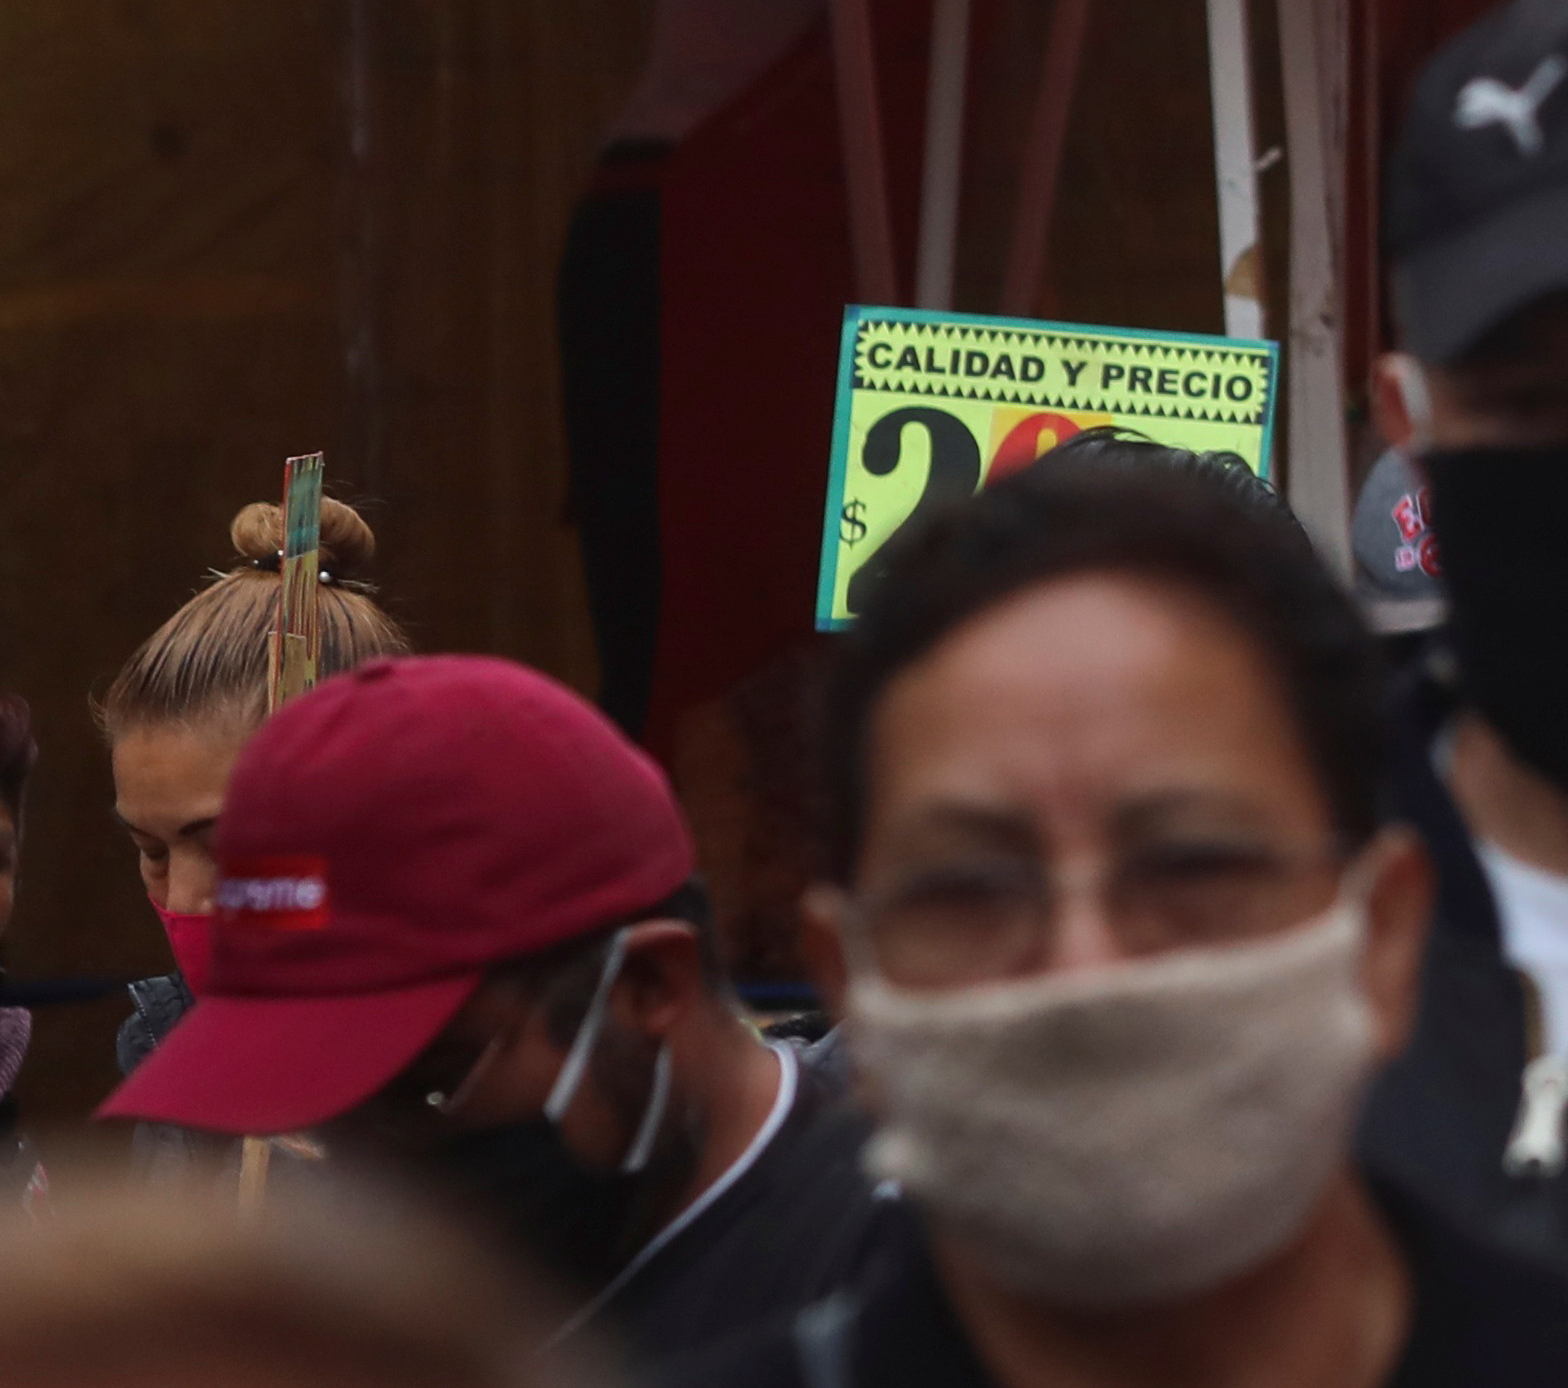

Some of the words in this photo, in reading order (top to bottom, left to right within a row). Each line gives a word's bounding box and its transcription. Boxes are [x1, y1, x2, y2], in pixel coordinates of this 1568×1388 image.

[867, 342, 1046, 383] CALIDAD
[1060, 360, 1089, 387] Y
[1101, 364, 1254, 403] PRECIO
